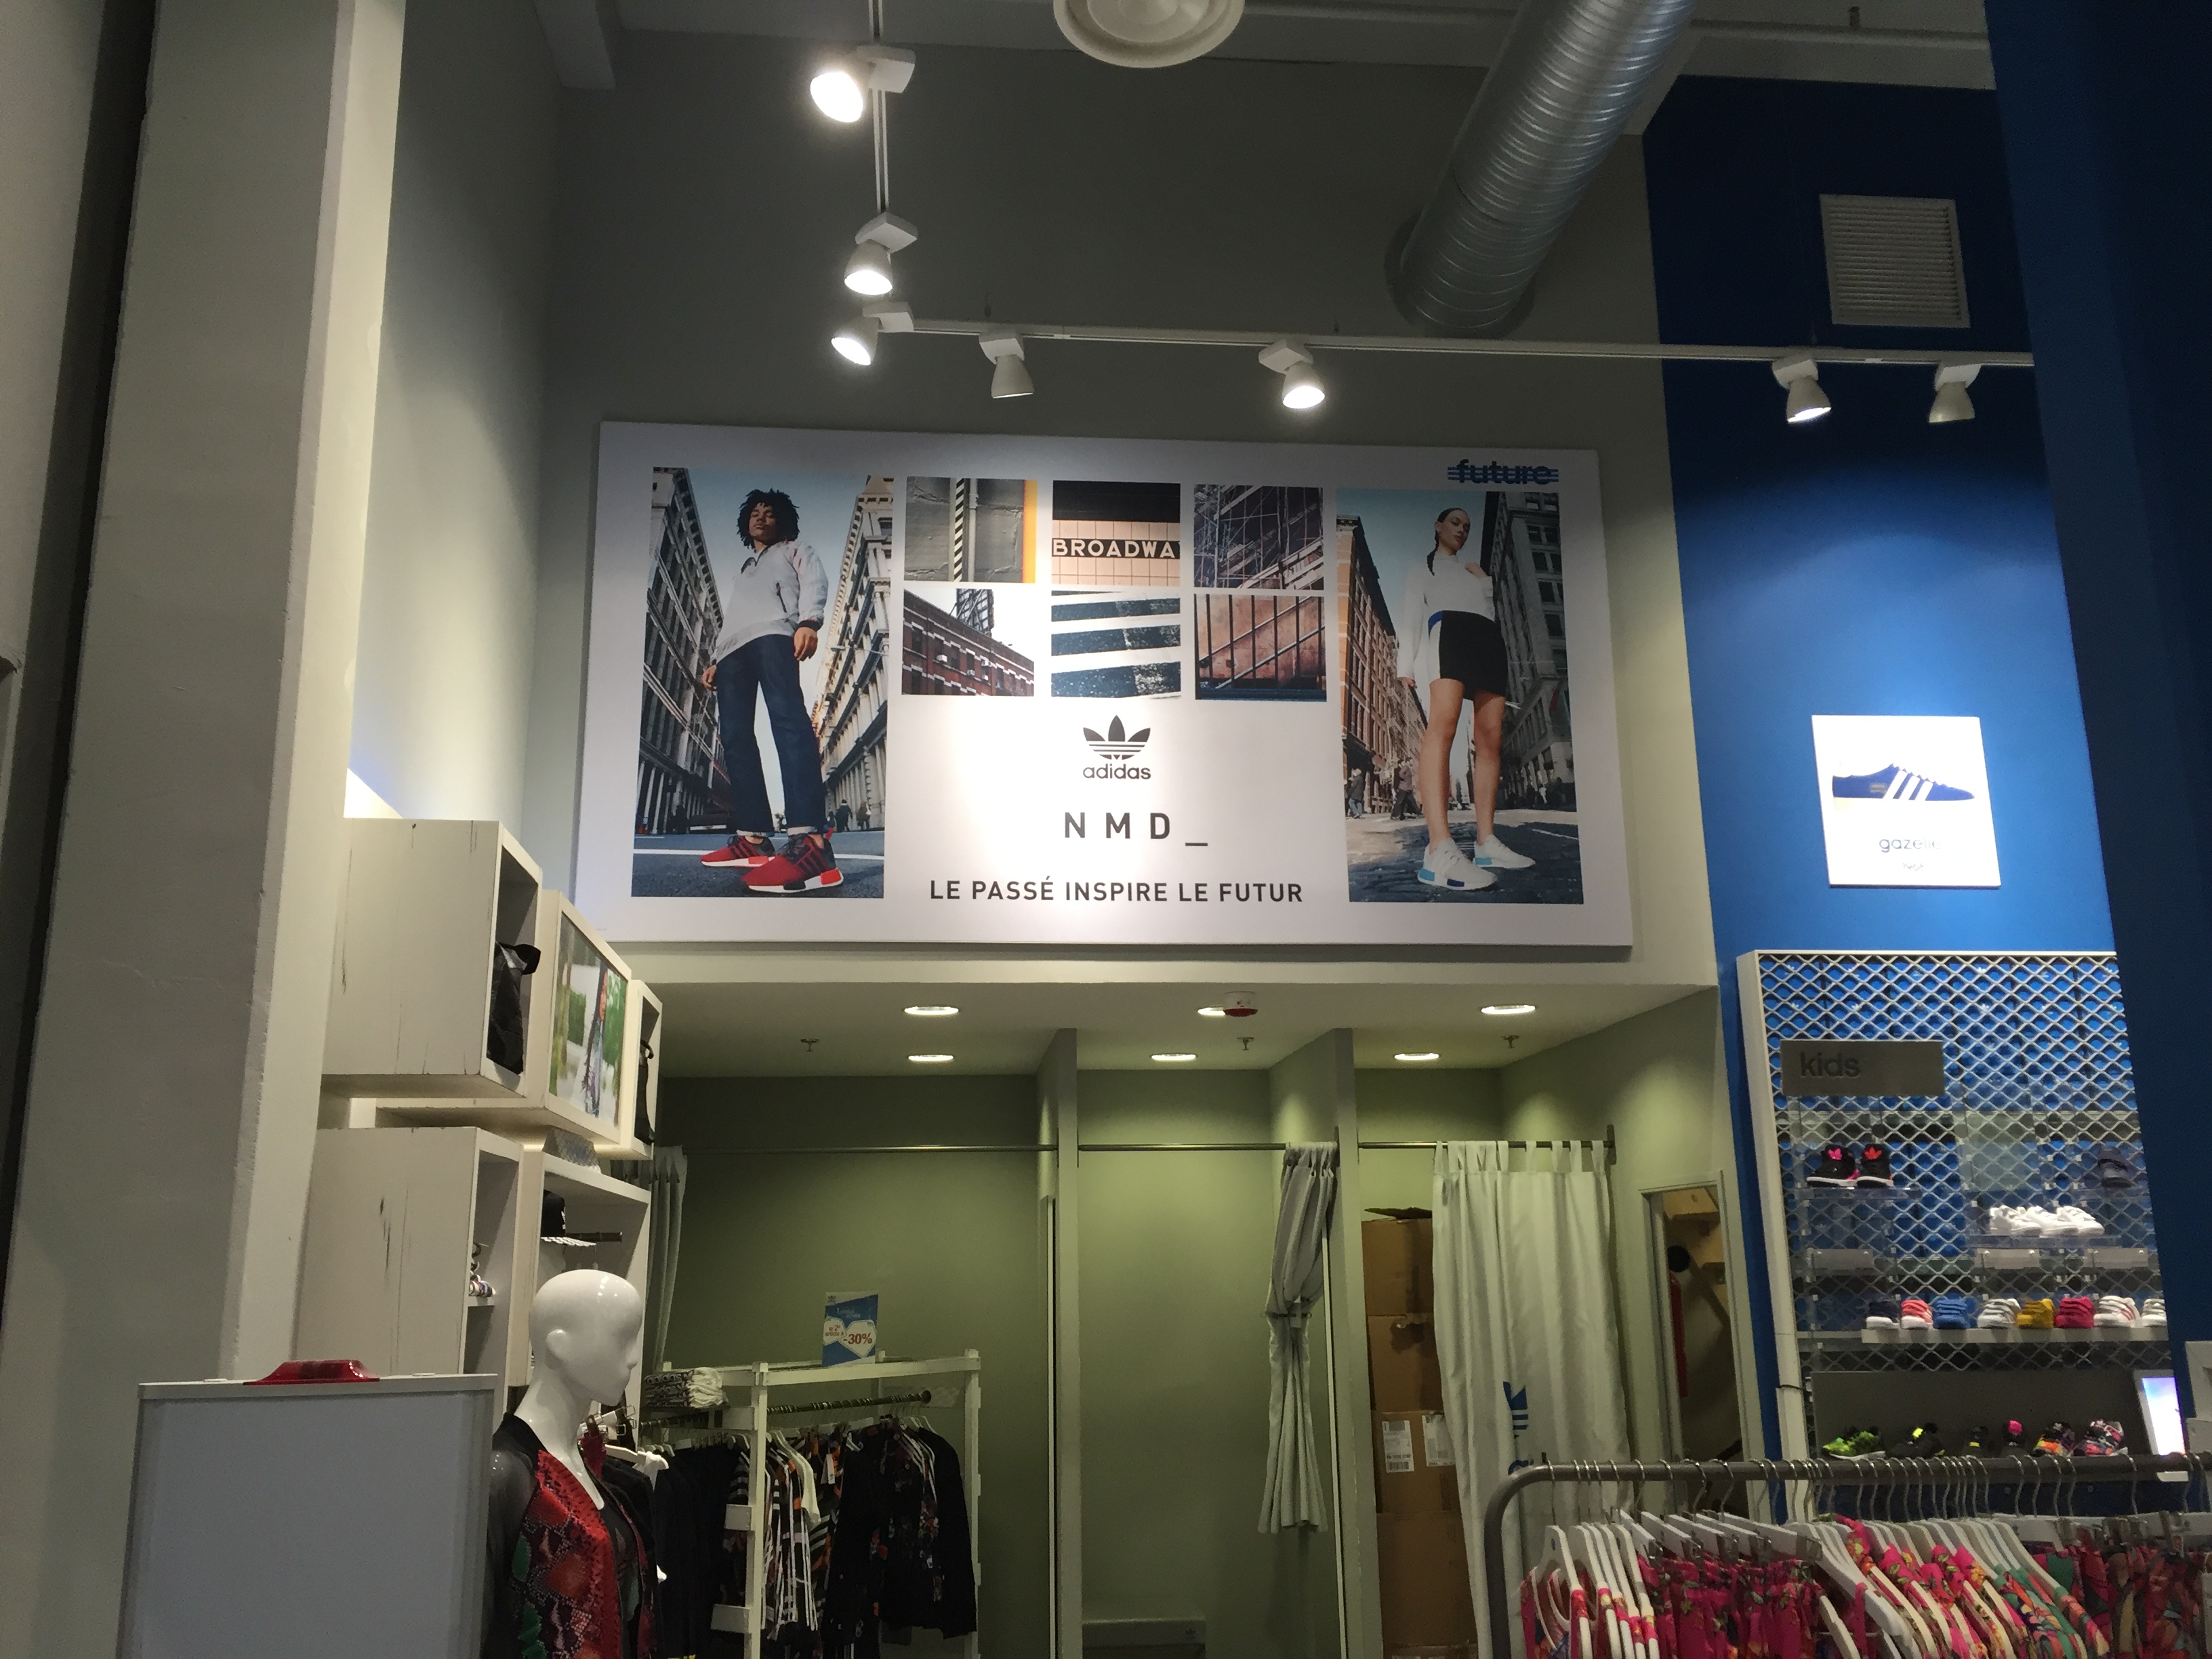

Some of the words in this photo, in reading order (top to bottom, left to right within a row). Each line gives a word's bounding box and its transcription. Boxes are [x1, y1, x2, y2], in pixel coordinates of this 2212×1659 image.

[1456, 458, 1551, 485] future
[1052, 539, 1180, 558] BROADWA
[1082, 763, 1151, 779] adidas
[930, 880, 960, 900] LE
[972, 876, 1053, 901] PASSÉ
[1065, 882, 1167, 902] INSPIRE
[1179, 882, 1208, 902] LE
[1219, 882, 1303, 903] FUTUR
[1800, 1052, 1861, 1078] kids
[843, 1332, 873, 1345] -30%
